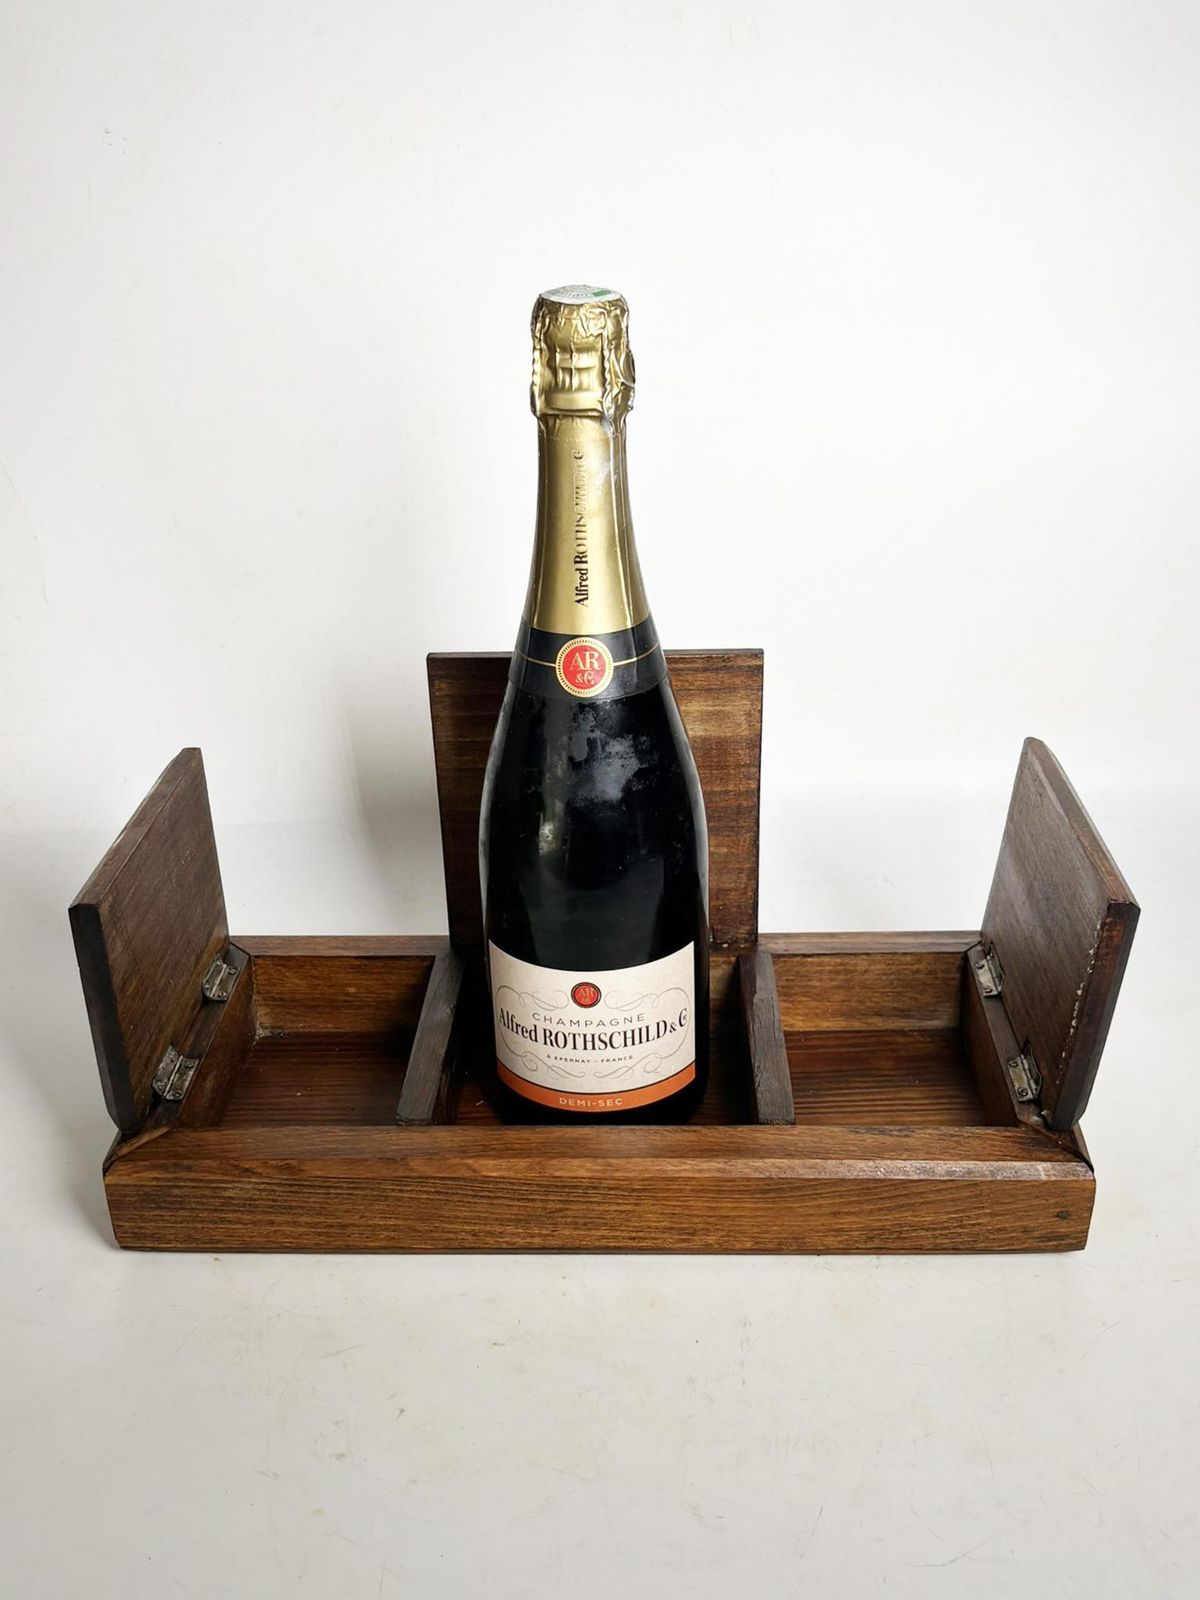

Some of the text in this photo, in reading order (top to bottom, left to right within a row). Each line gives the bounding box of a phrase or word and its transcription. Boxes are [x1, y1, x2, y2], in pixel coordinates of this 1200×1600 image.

[573, 568, 589, 607] Alfred
[570, 651, 600, 670] AR
[499, 1007, 538, 1043] Alfred
[543, 1019, 667, 1051] ROTHSCHILD
[532, 1012, 646, 1028] CHAMPAGNE
[559, 1097, 623, 1107] DEMI-SEC
